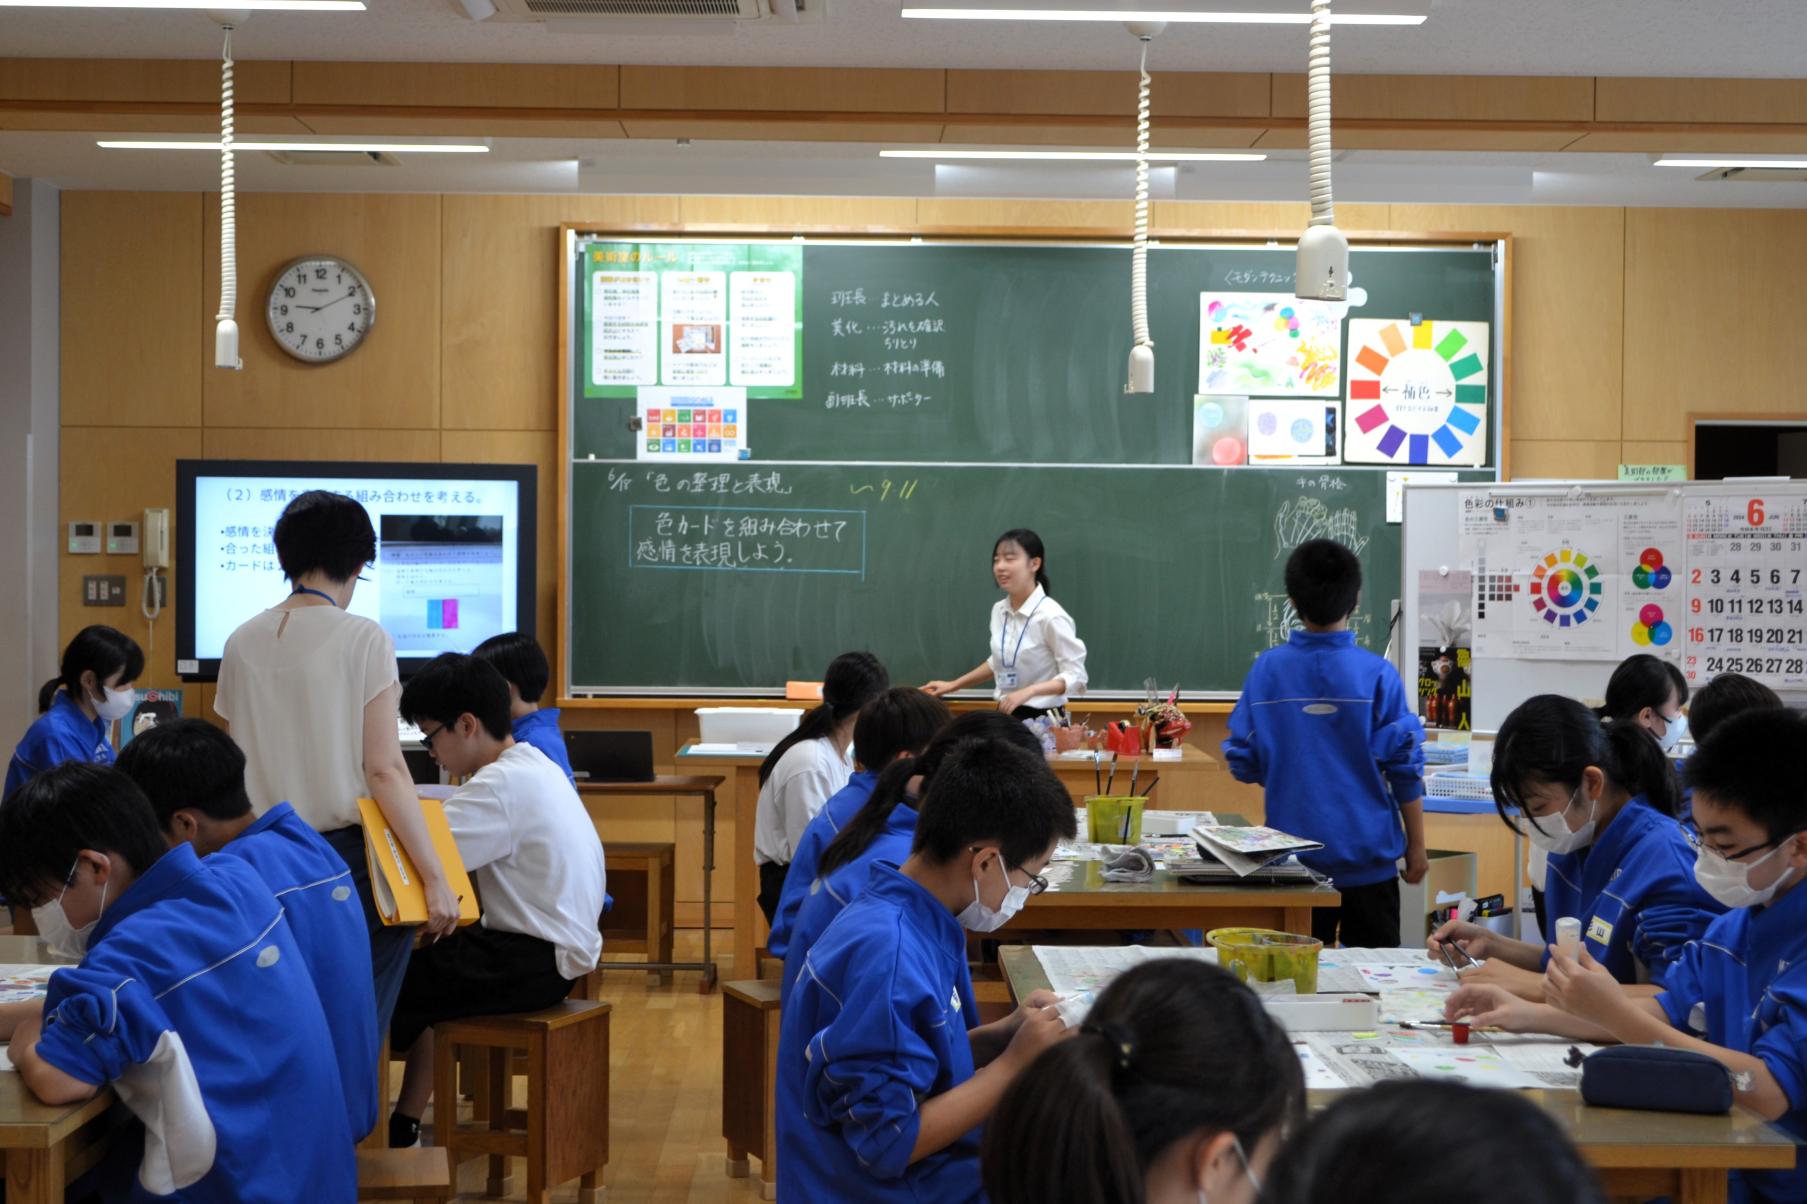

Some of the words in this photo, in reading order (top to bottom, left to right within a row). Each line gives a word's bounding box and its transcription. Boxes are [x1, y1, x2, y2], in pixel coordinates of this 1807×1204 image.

[297, 273, 307, 284] 11
[315, 268, 327, 280] 12
[336, 273, 342, 285] 1
[284, 287, 296, 298] 10
[347, 286, 356, 297] 2
[881, 290, 940, 309] まとめる人
[280, 304, 289, 316] 9
[353, 304, 361, 315] 3
[286, 321, 294, 333] 8
[347, 321, 355, 332] 4
[300, 334, 308, 345] 7
[316, 338, 325, 350] 6
[334, 334, 343, 345] 5
[830, 360, 866, 379] 材料
[1747, 498, 1766, 527] 6
[655, 511, 848, 542] 色カードを組み合わせて
[1730, 542, 1742, 552] 28
[1750, 542, 1762, 552] 29
[1770, 542, 1782, 552] 30
[1790, 542, 1801, 552] 31
[1691, 569, 1702, 584] 2
[1710, 569, 1721, 584] 3
[1730, 569, 1741, 584] 4
[1750, 569, 1760, 584] 5
[1770, 569, 1781, 584] 6
[1790, 569, 1801, 584] 7
[1691, 598, 1702, 614] 9
[1707, 598, 1724, 614] 10
[1727, 598, 1743, 614] 11
[1747, 598, 1764, 614] 12
[1767, 598, 1784, 614] 13
[1787, 598, 1803, 614] 14
[1688, 628, 1704, 643] 16
[1707, 628, 1724, 643] 17
[1727, 628, 1744, 643] 18
[1747, 628, 1763, 643] 19
[1766, 628, 1784, 643] 20
[1787, 628, 1803, 643] 21
[1686, 656, 1697, 665] 23
[1706, 657, 1724, 672] 24
[1726, 657, 1744, 672] 25
[1746, 658, 1763, 673] 26
[1766, 658, 1783, 673] 27
[1785, 659, 1804, 674] 28
